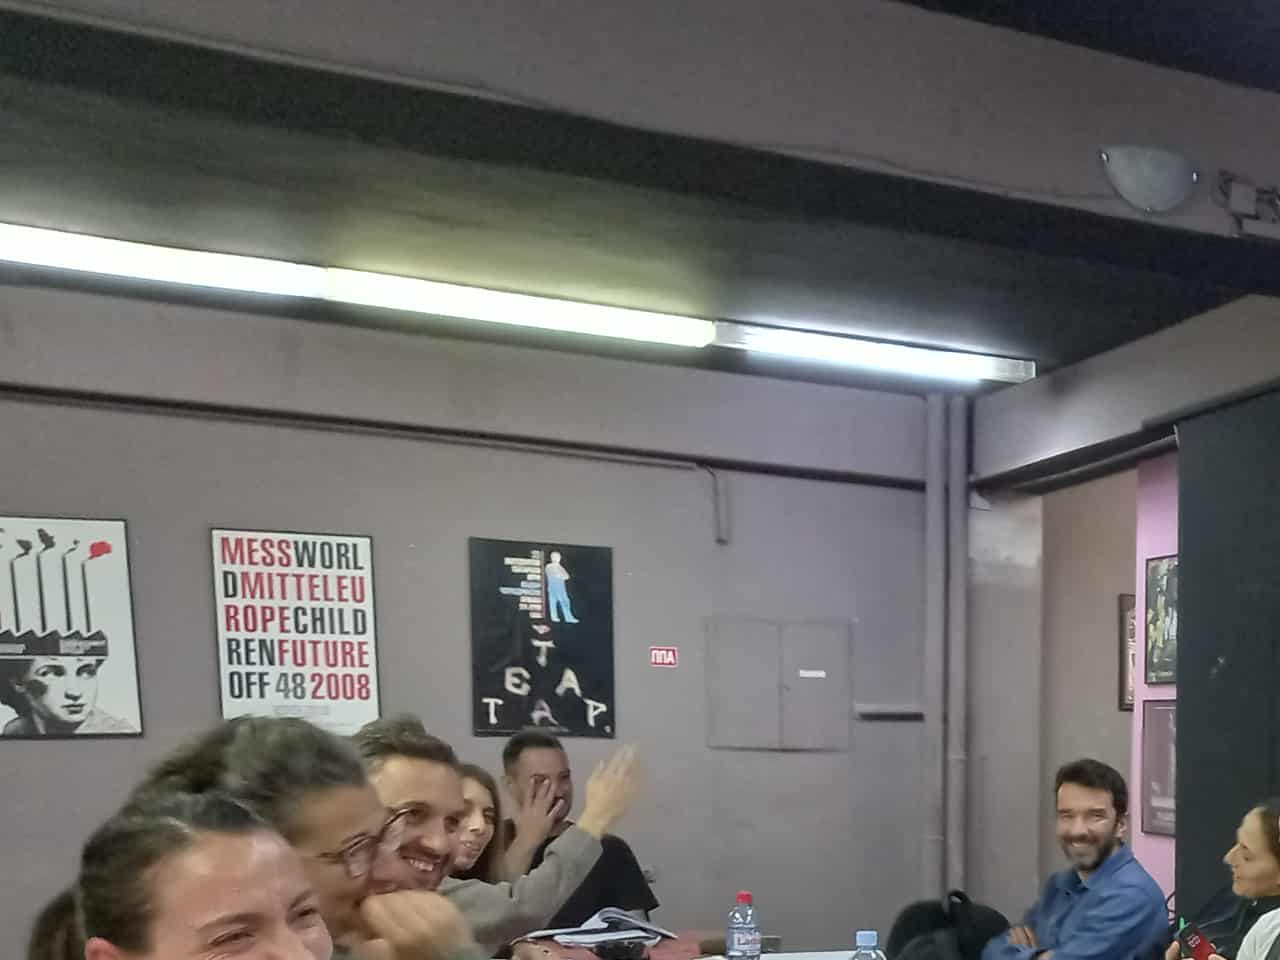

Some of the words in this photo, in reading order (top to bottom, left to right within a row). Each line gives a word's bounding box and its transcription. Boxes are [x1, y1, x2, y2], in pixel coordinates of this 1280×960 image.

[229, 671, 271, 699] OFF
[275, 672, 306, 700] 48
[310, 672, 371, 701] 2008
